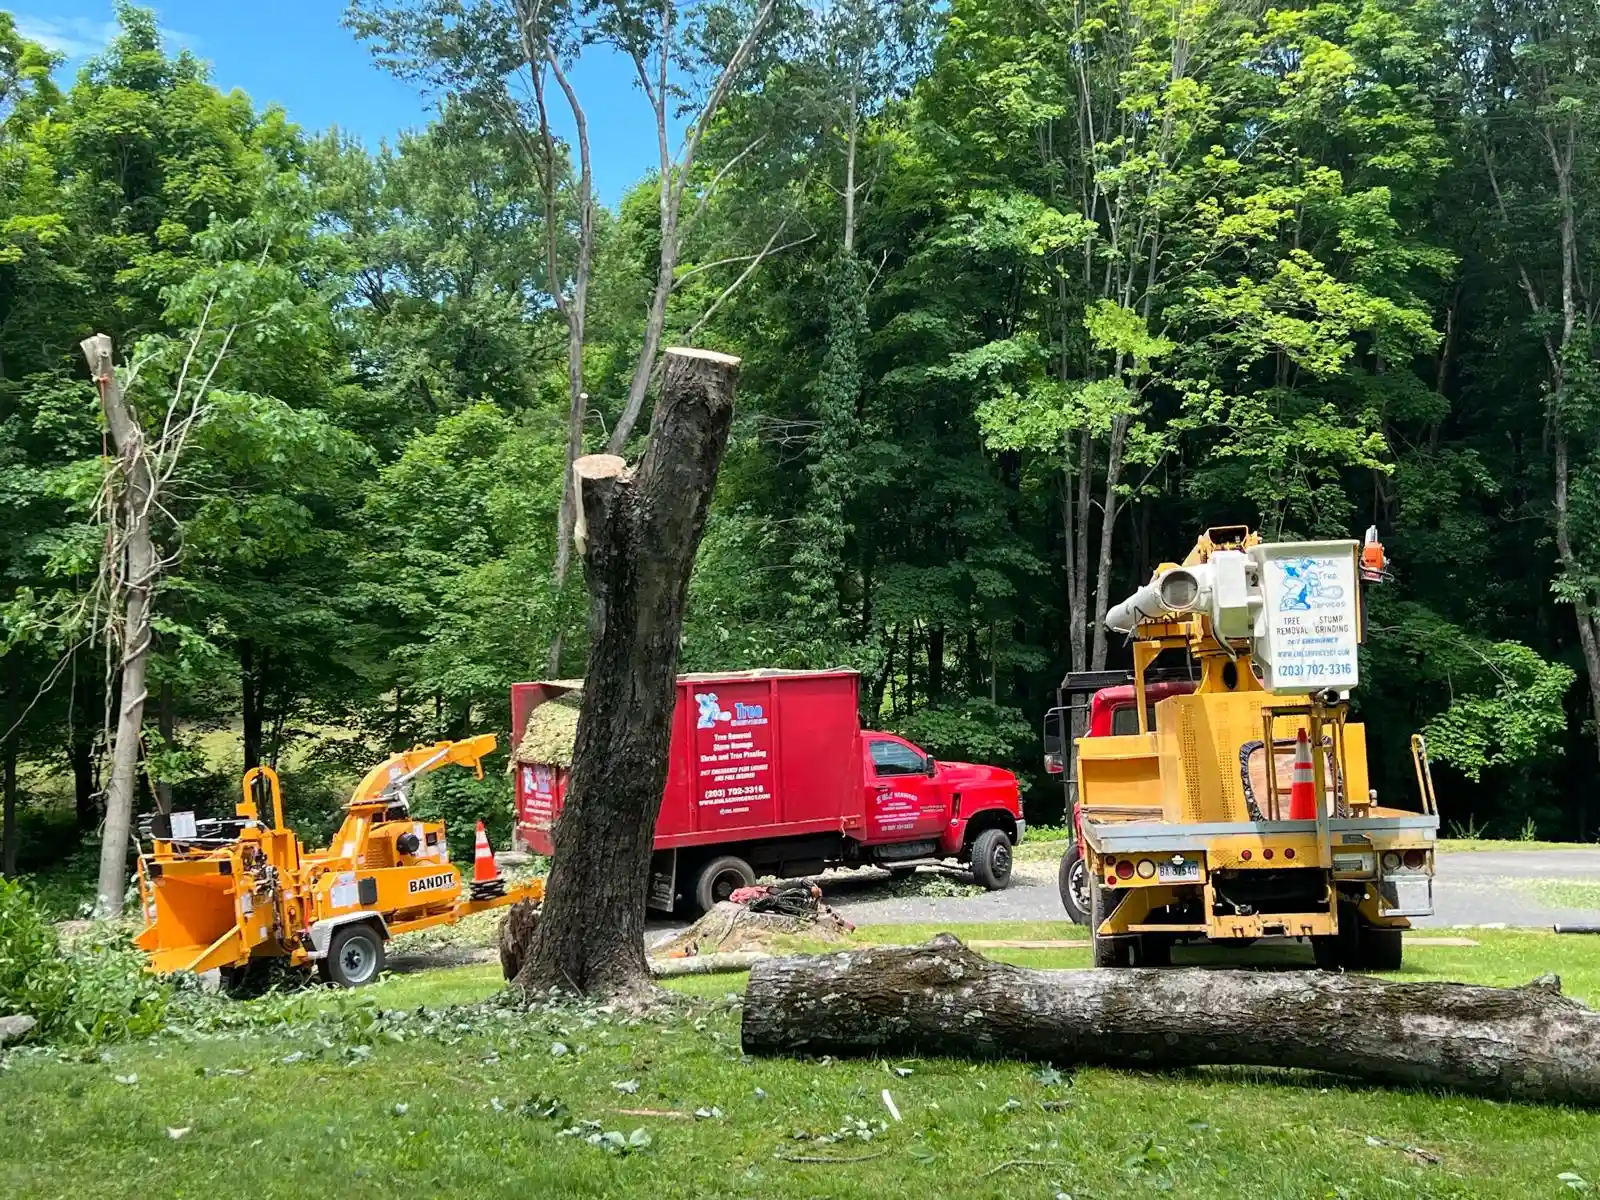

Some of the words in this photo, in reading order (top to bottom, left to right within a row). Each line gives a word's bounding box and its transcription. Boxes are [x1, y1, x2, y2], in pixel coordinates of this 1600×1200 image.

[1284, 616, 1300, 625] TREE
[1319, 615, 1344, 624] STUMP
[1276, 626, 1308, 636] REMOVAL
[1315, 624, 1349, 634] GRINDING
[1278, 664, 1303, 677] (203)
[1306, 663, 1352, 676] 702-3316
[735, 703, 762, 718] Tree
[730, 752, 743, 760] Tree
[704, 788, 725, 799] (203)
[727, 785, 764, 796] 702-3316
[409, 873, 453, 893] BANDIT
